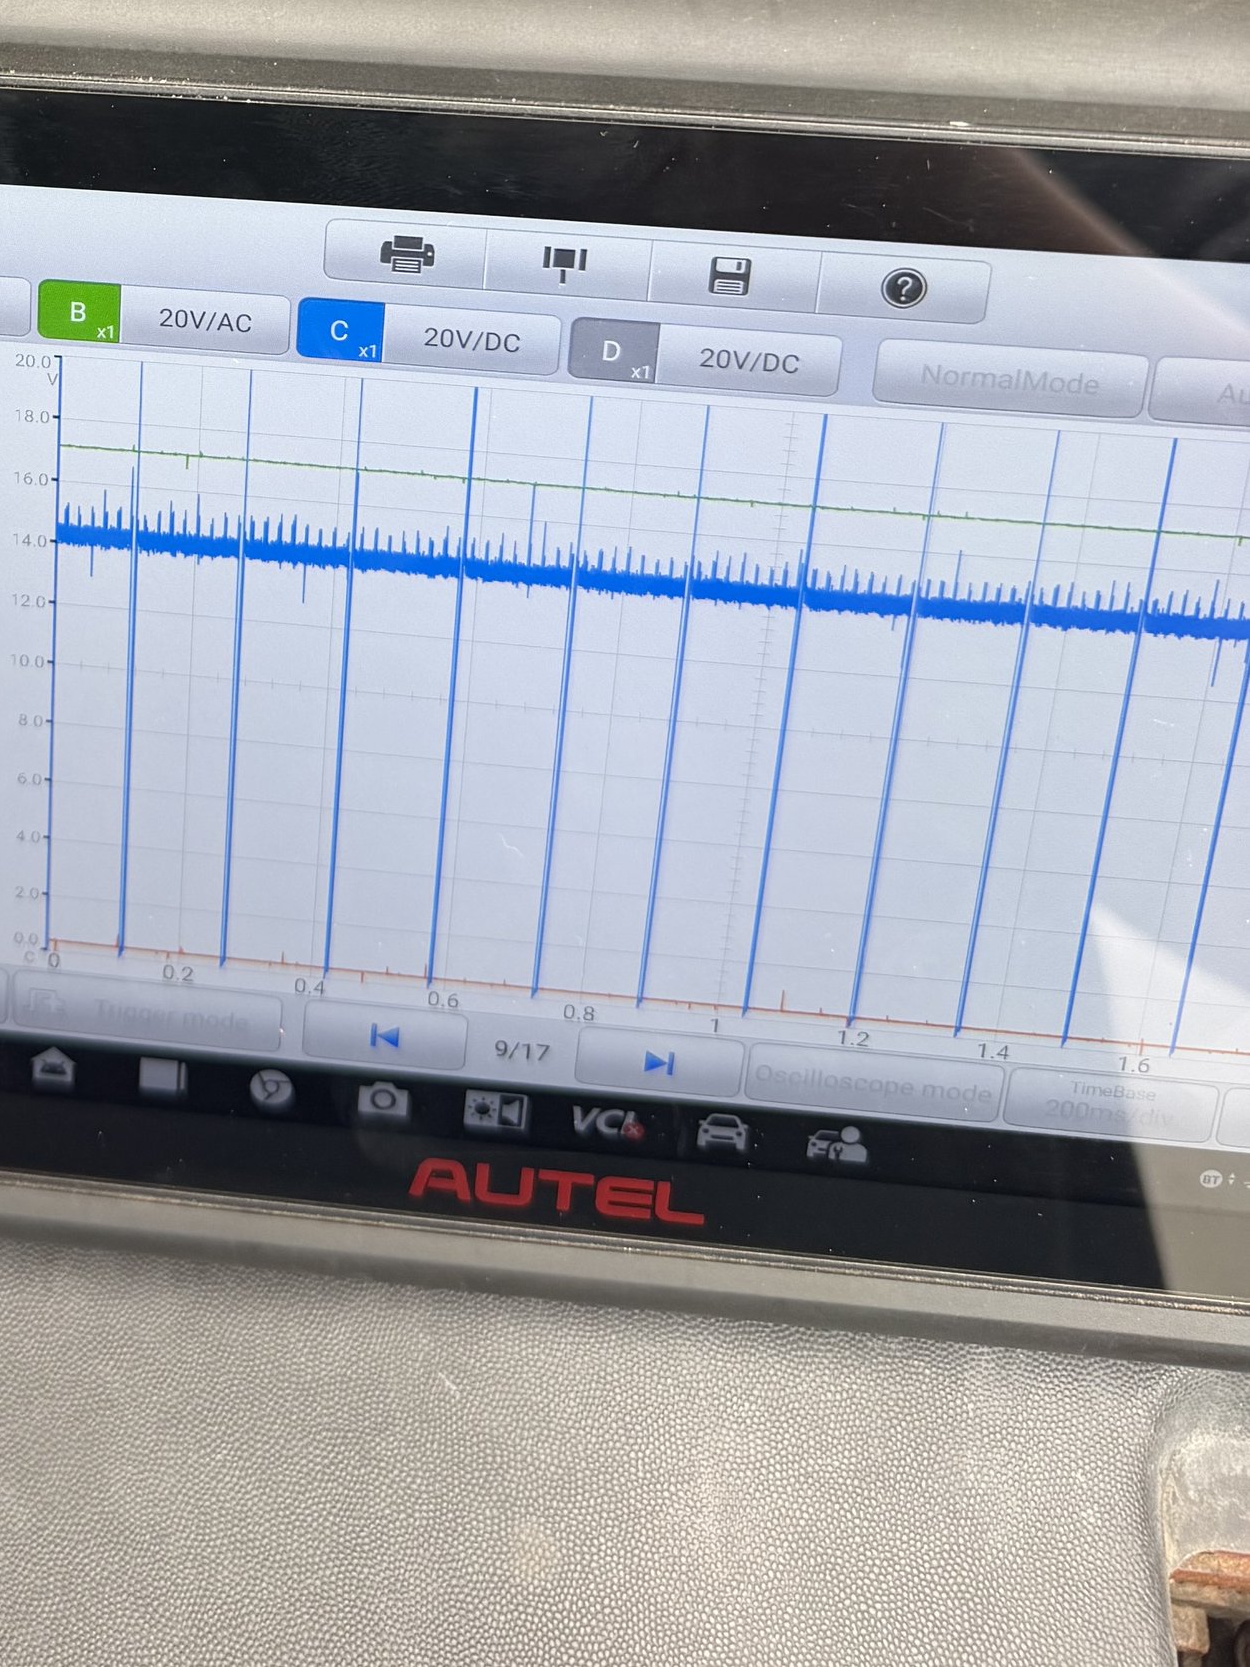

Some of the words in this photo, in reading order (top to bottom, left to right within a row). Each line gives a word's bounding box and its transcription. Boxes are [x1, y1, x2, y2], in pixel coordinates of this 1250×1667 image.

[70, 301, 87, 322] B
[159, 308, 253, 333] 20V/AC
[97, 325, 115, 340] x1
[330, 320, 349, 341] C
[424, 327, 521, 353] 20V/DC
[358, 344, 377, 359] x1
[602, 340, 621, 362] D
[15, 353, 51, 369] 20.0
[699, 348, 800, 374] 20V/DC
[47, 373, 58, 386] V
[630, 365, 650, 380] x1
[920, 363, 1100, 395] NormalMode
[15, 409, 50, 424] 18.0
[14, 471, 48, 486] 16.0
[13, 533, 47, 548] 14.0
[12, 593, 46, 608] 12.0
[11, 654, 44, 668] 10.0
[18, 714, 43, 727] 8.0
[17, 772, 42, 786] 6.0
[16, 831, 41, 844] 4.0
[15, 886, 40, 900] 2.0
[14, 932, 39, 946] 0.0
[24, 950, 35, 963] C
[48, 952, 60, 968] 0
[162, 964, 194, 982] 0.2
[295, 978, 325, 996] 0.4
[427, 990, 459, 1008] 0.6
[563, 1003, 595, 1021] 0.8
[710, 1018, 719, 1033] 1
[838, 1030, 870, 1047] 1.2
[494, 1040, 550, 1061] 9/17
[978, 1043, 1010, 1060] 1.4
[1119, 1056, 1150, 1073] 1.6
[756, 1064, 914, 1097] Oscilloscope
[921, 1085, 992, 1104] mode
[1072, 1081, 1156, 1101] TimeBase
[1045, 1099, 1174, 1127] 200ms/div
[1202, 1173, 1221, 1185] BT
[409, 1157, 704, 1225] AUTEL
